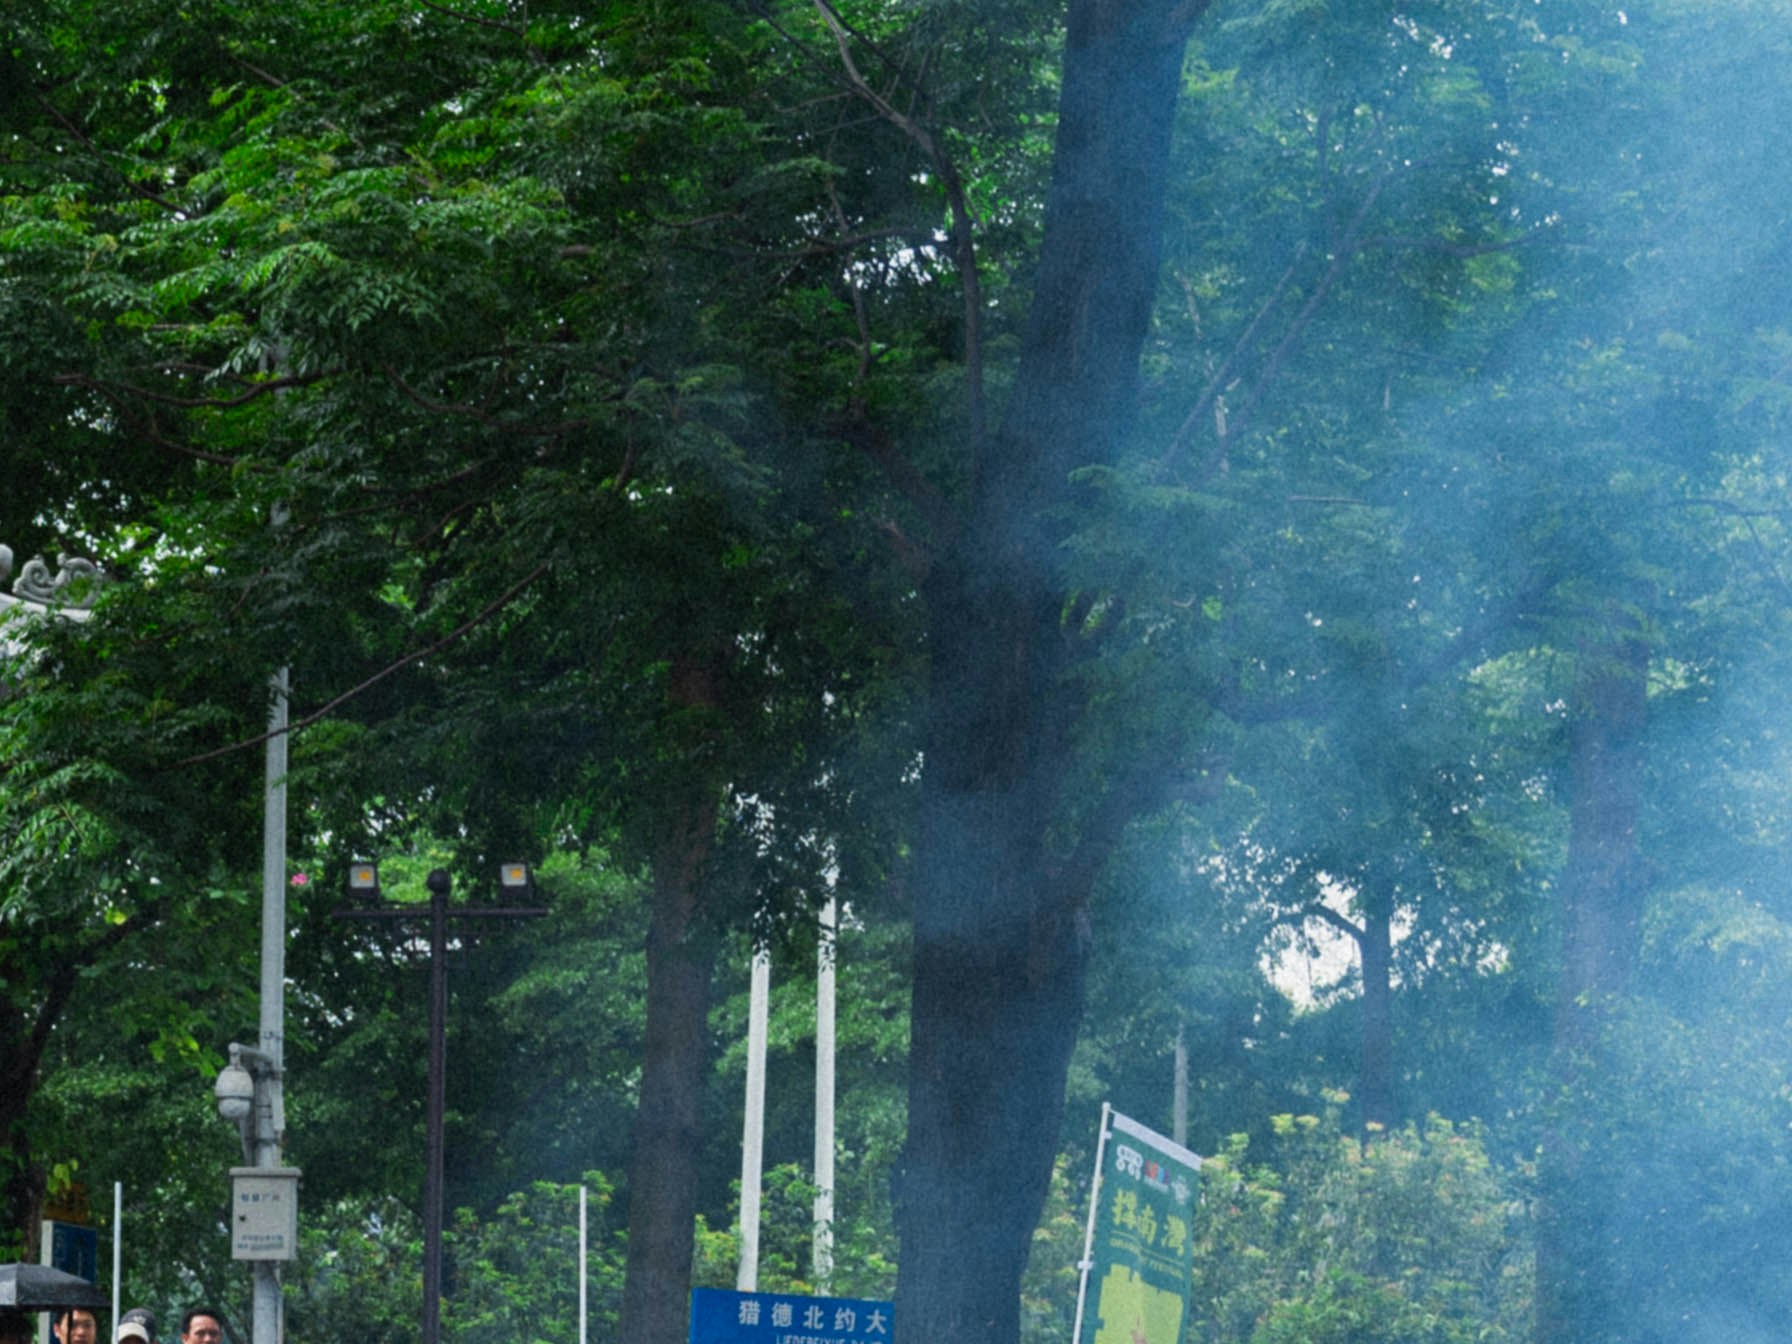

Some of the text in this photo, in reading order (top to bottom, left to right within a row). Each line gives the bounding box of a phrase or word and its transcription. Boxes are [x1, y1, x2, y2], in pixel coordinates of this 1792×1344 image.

[738, 1299, 888, 1335] 猎德北约大
